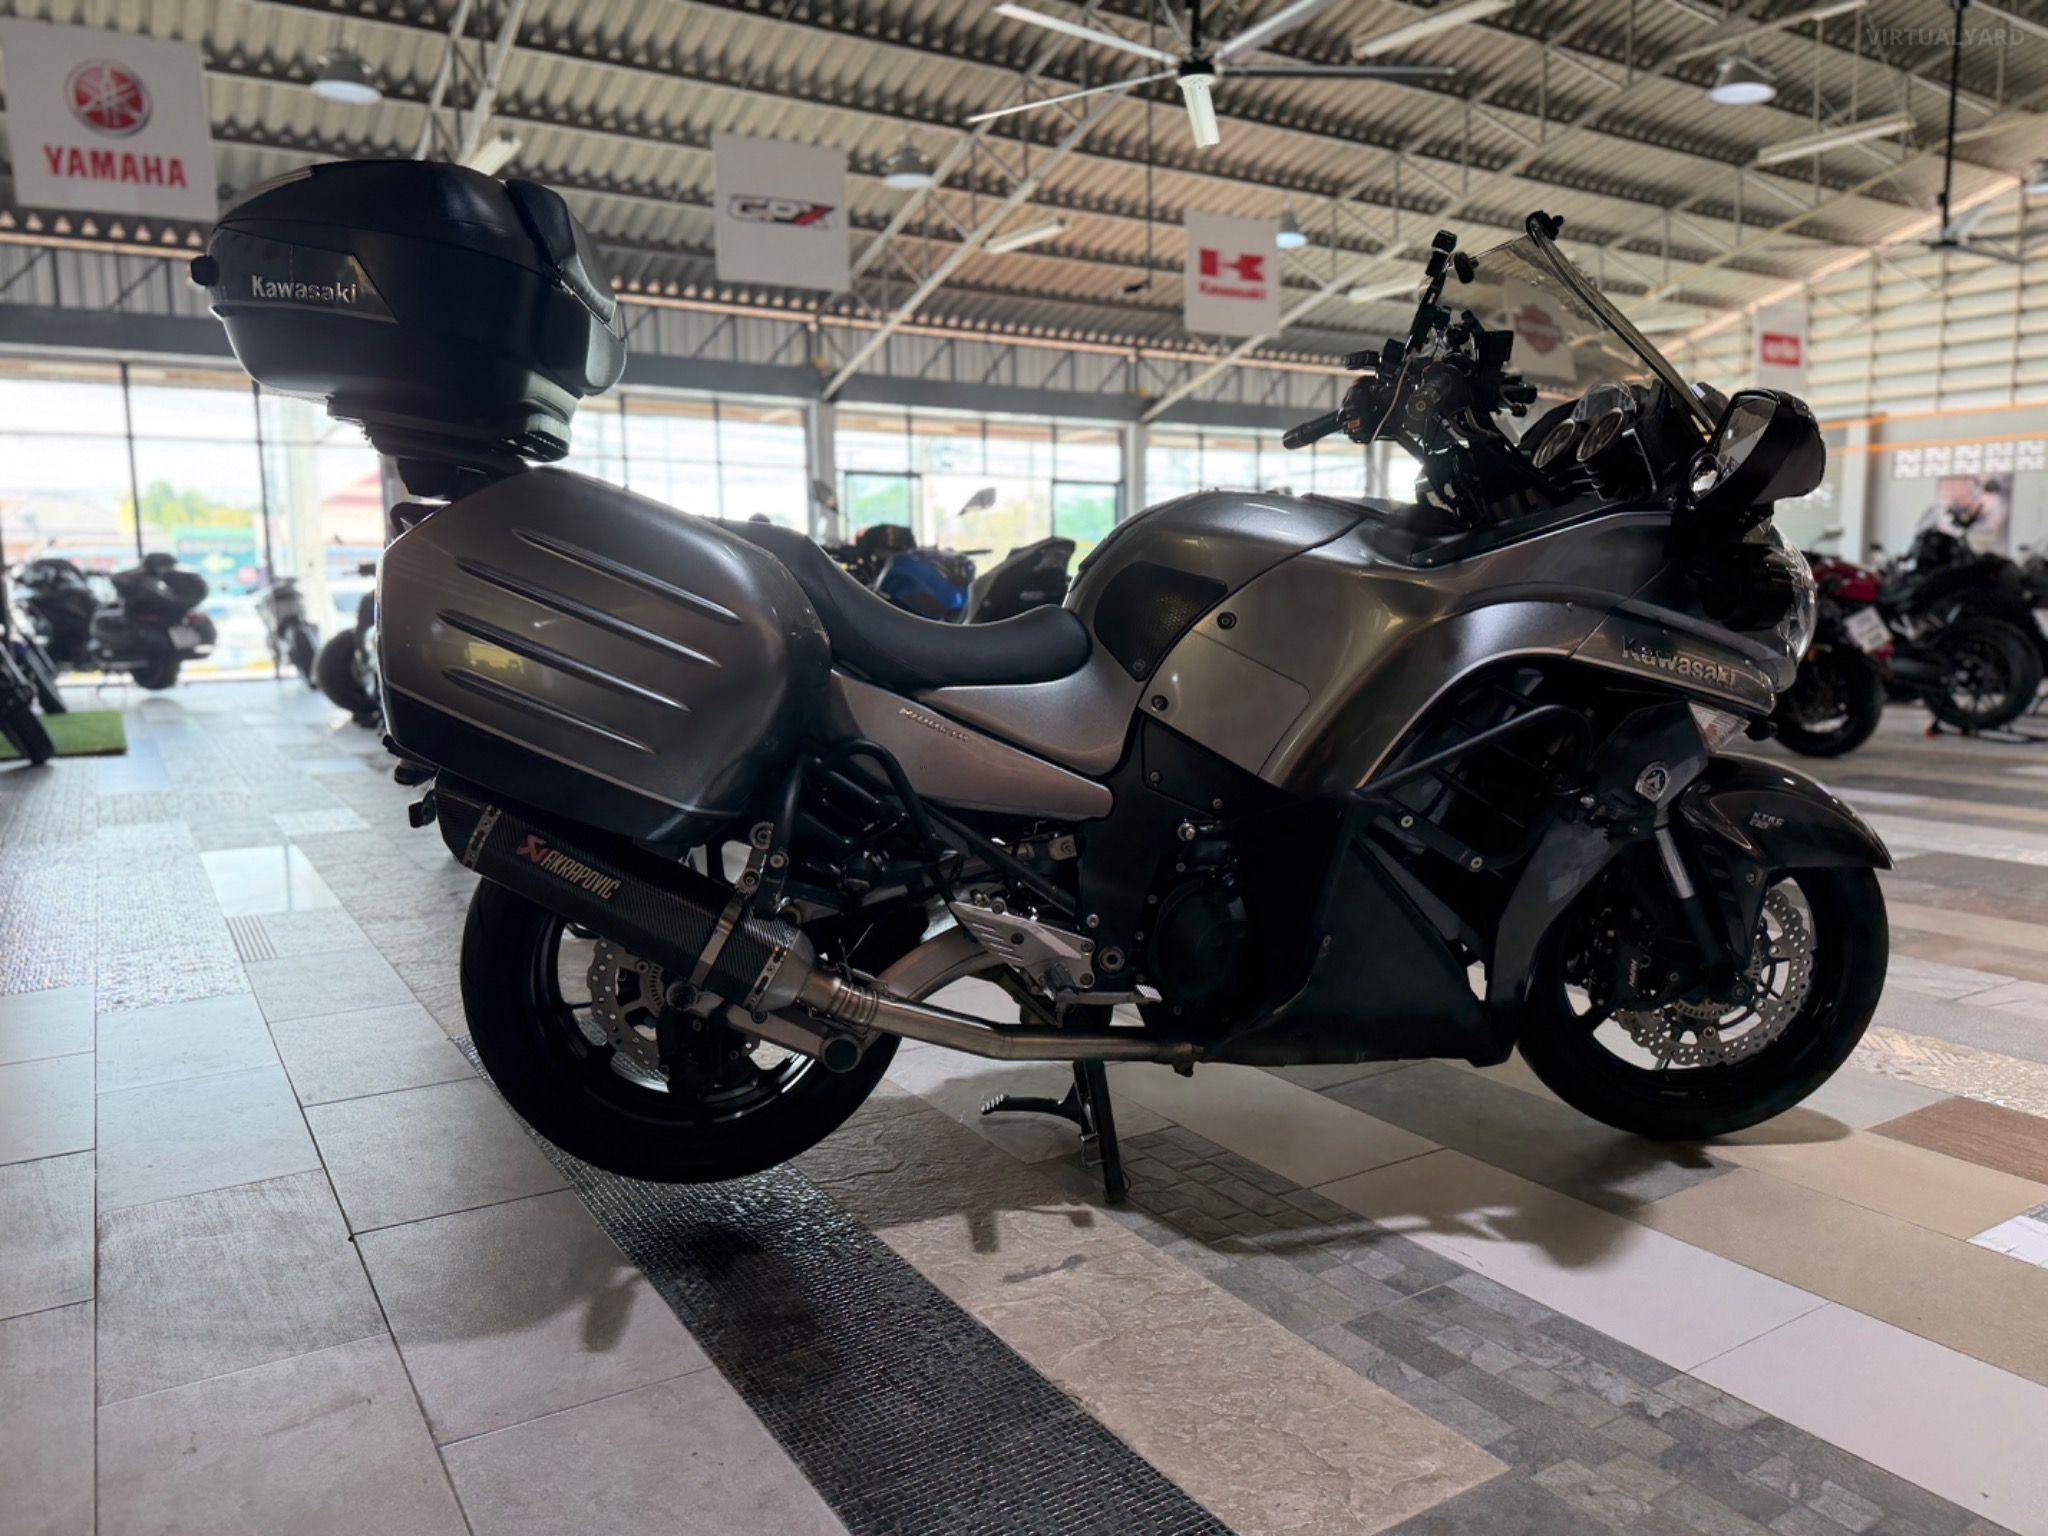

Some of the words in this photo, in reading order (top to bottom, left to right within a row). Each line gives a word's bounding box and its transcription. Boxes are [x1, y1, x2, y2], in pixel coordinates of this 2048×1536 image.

[43, 144, 188, 188] YAMAHA
[251, 274, 357, 303] Kawasaki
[1621, 635, 1737, 688] Kawasaki
